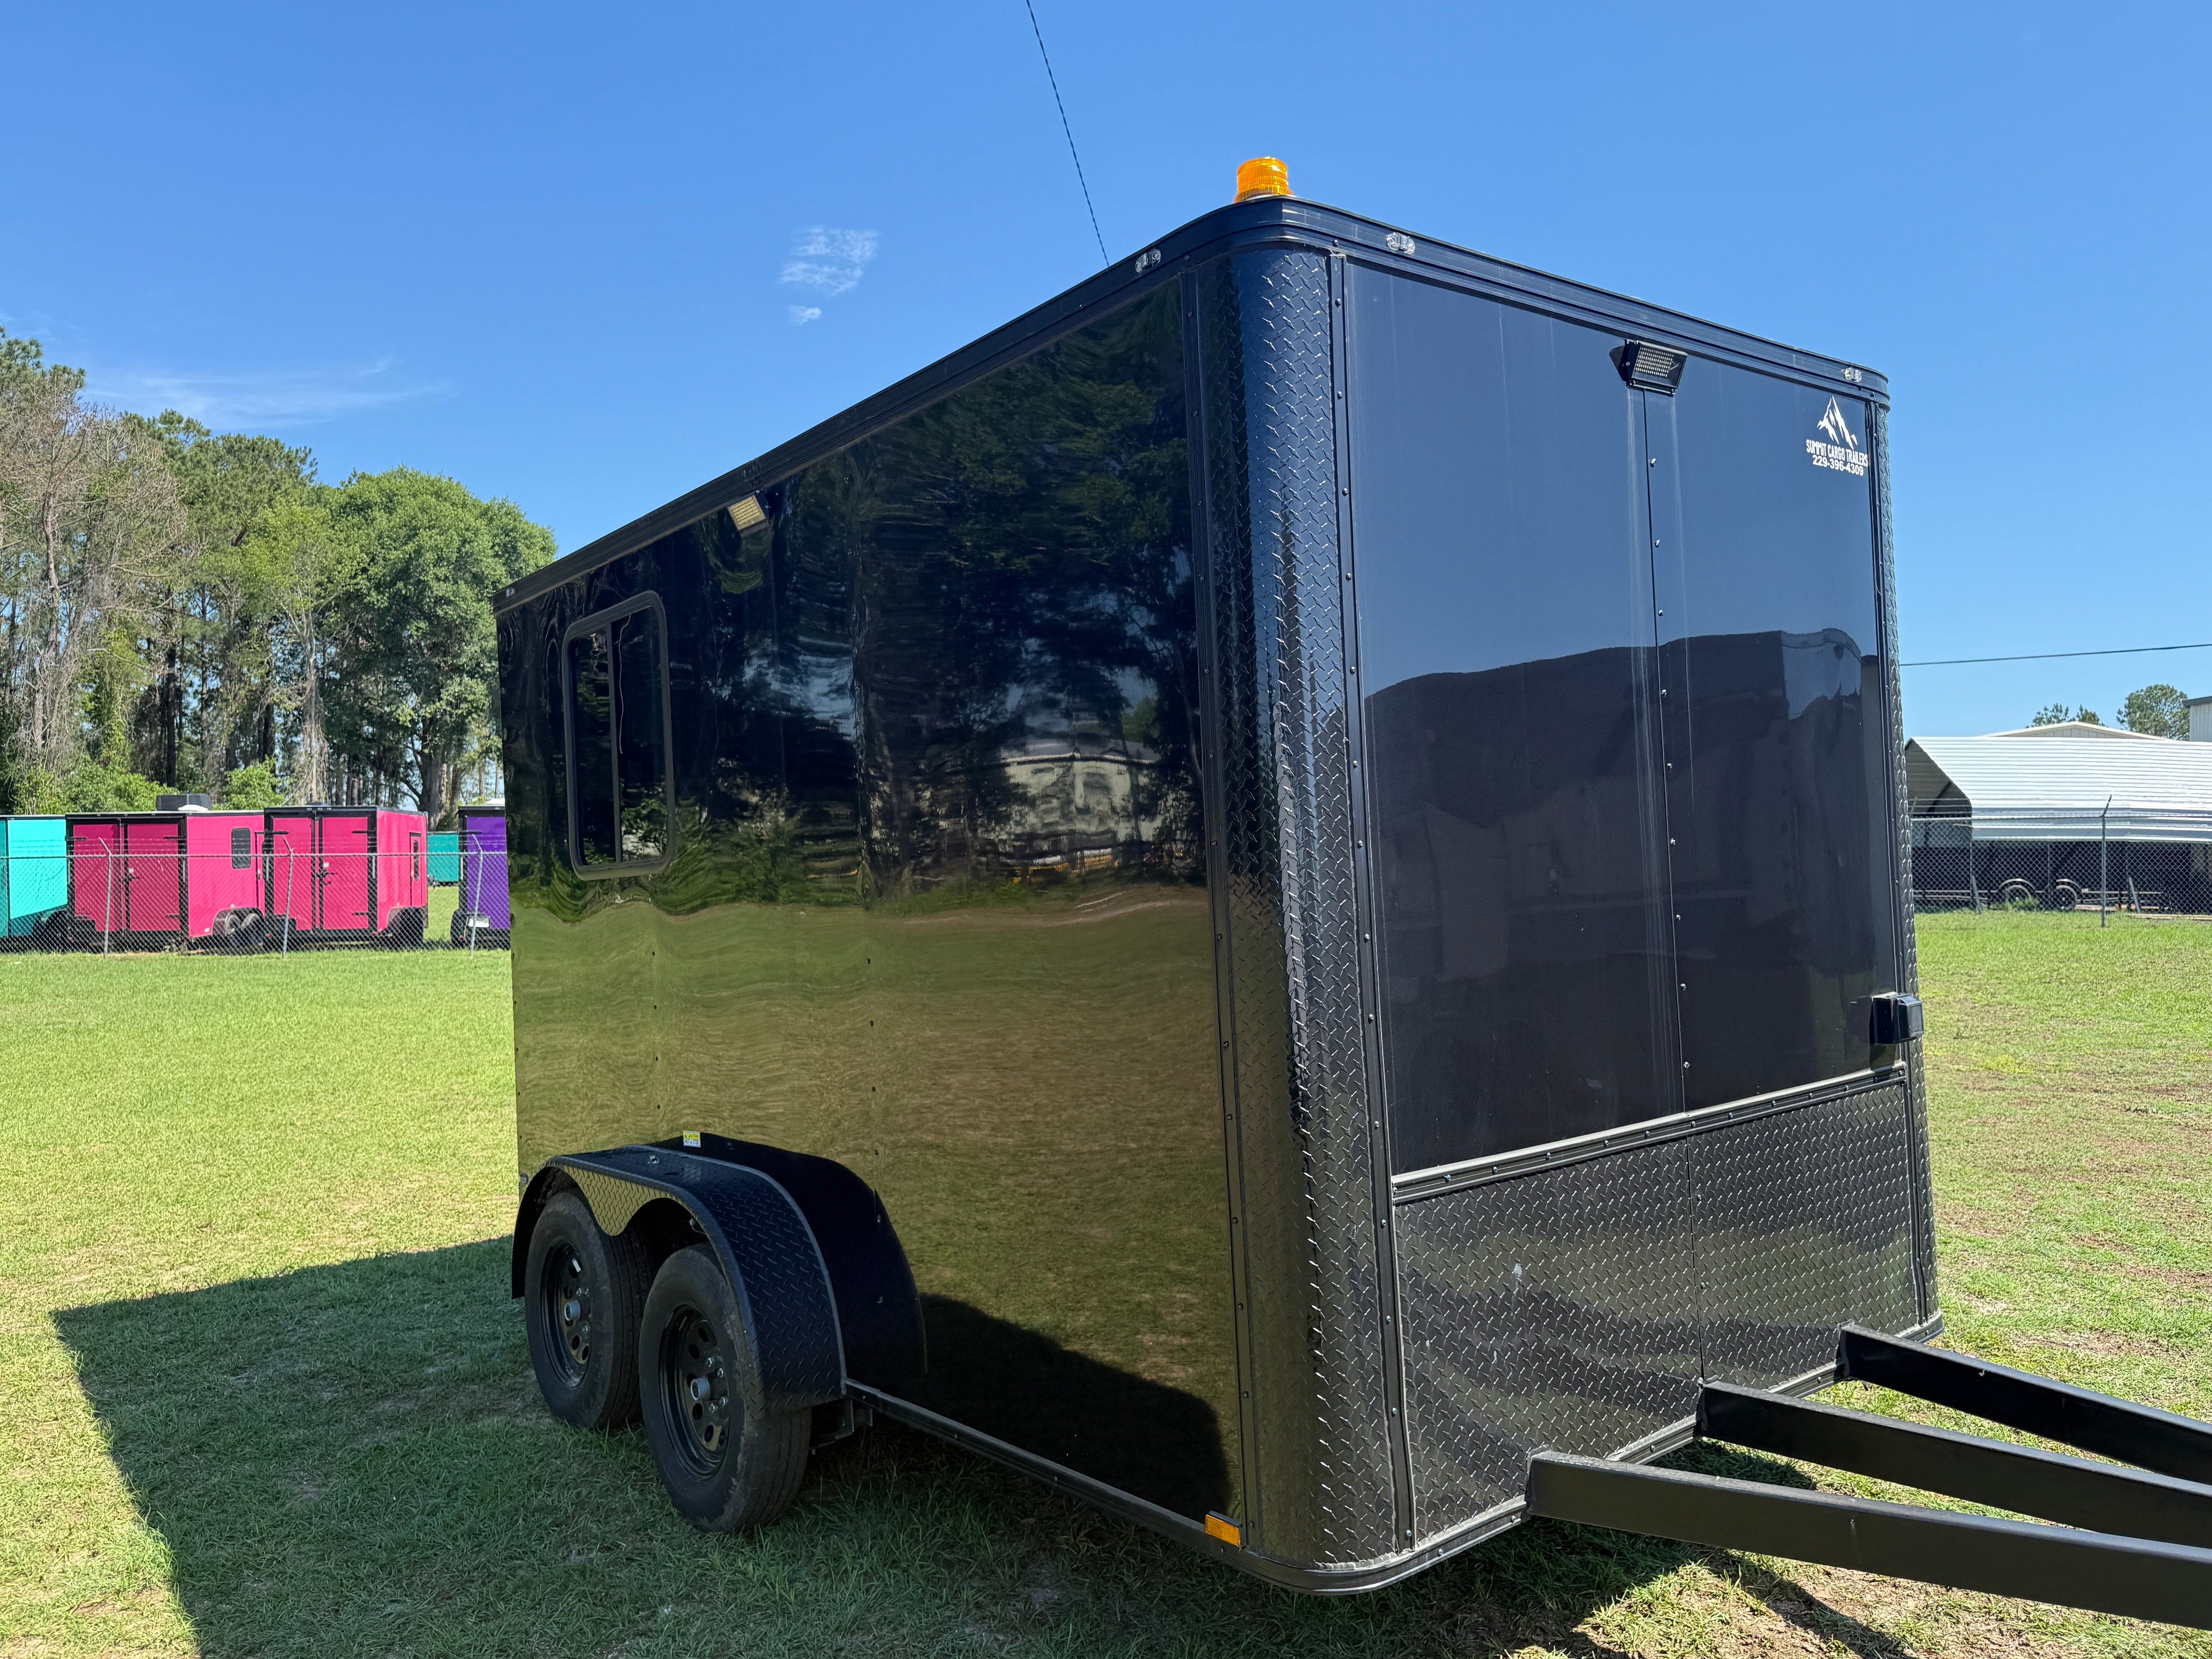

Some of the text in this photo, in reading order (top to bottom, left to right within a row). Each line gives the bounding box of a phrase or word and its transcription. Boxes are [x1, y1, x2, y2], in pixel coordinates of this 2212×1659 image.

[1806, 440, 1868, 467] SUMMIT CARGO TRAILERS
[1812, 454, 1863, 476] 229-396-4309
